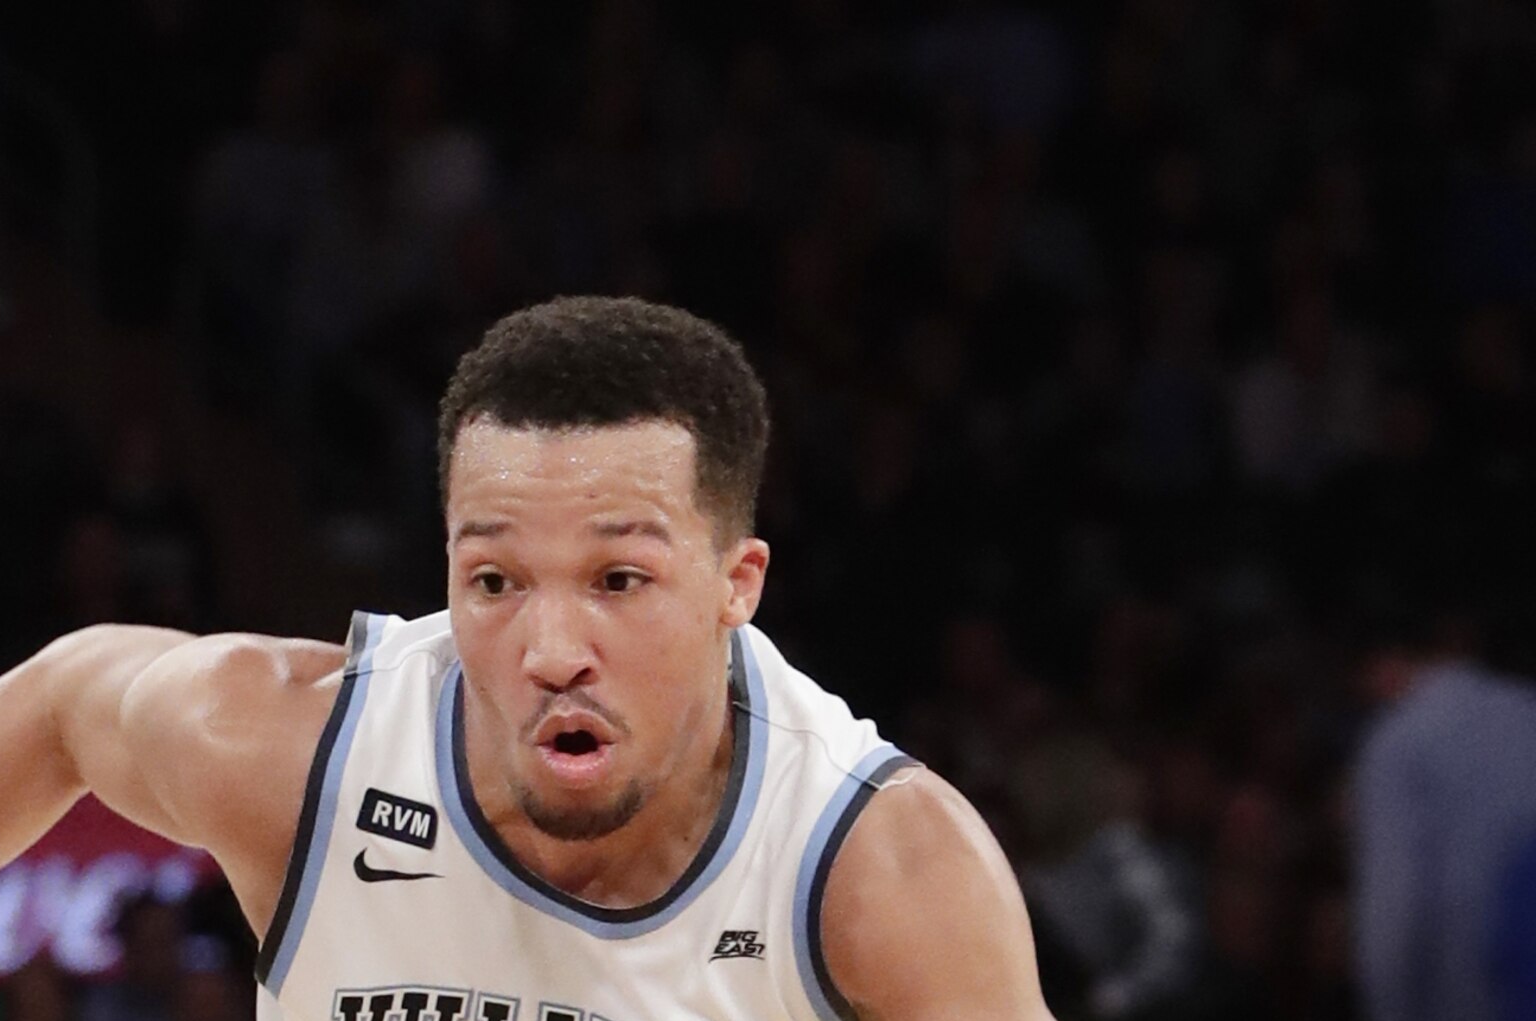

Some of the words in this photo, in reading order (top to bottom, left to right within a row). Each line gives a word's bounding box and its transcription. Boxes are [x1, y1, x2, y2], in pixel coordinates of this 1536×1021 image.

[371, 799, 431, 839] RVM
[720, 930, 760, 943] BIG
[713, 942, 766, 956] EAST
